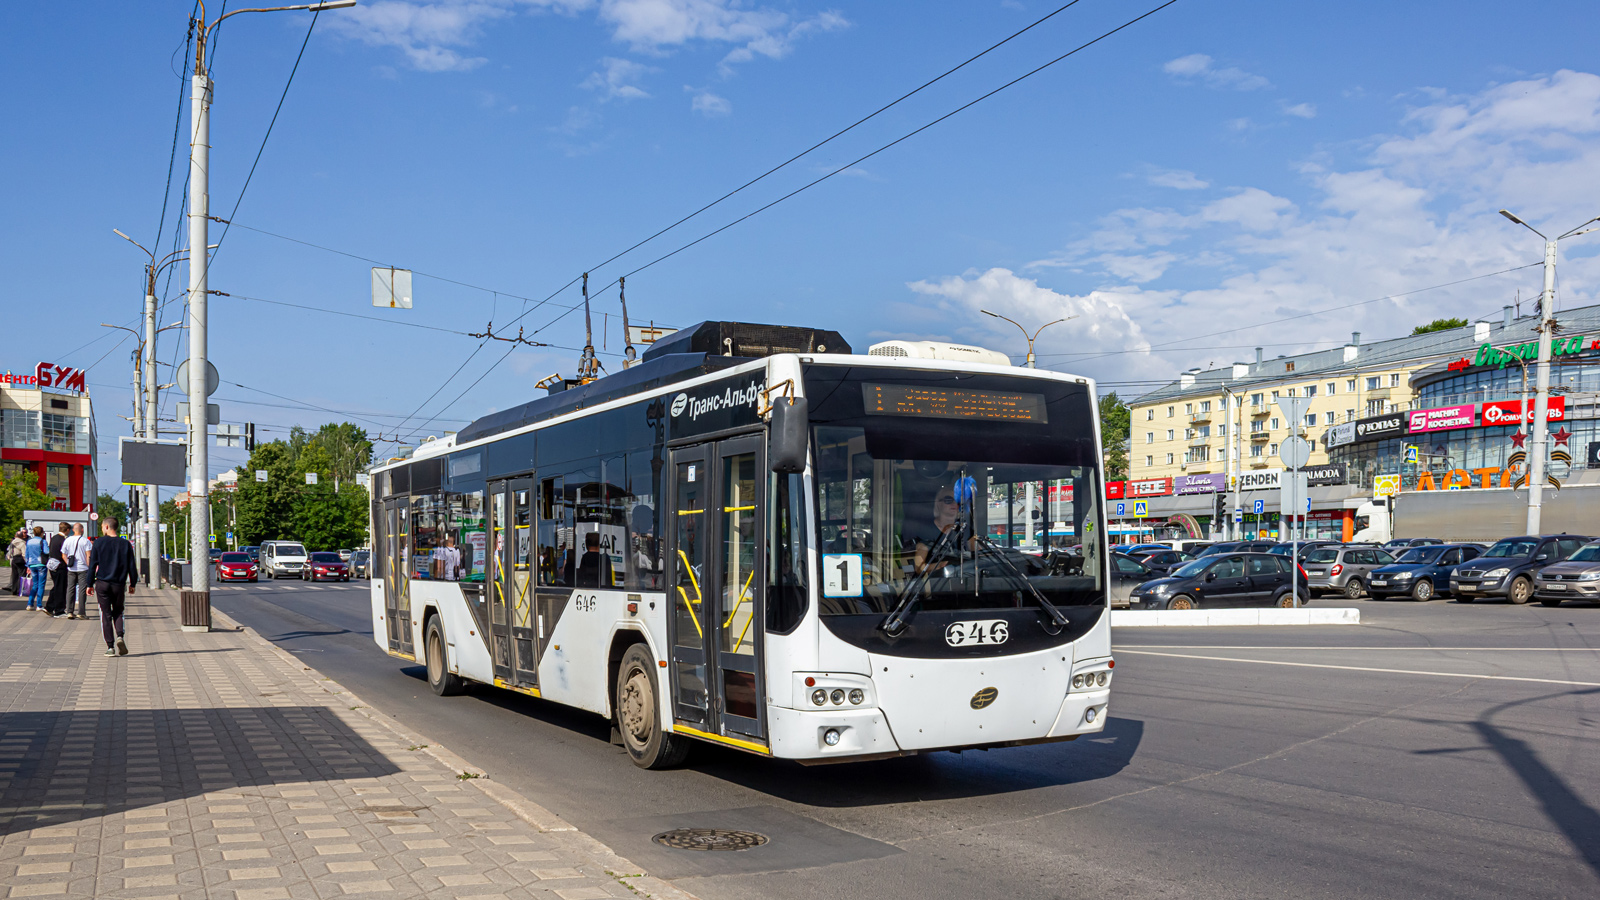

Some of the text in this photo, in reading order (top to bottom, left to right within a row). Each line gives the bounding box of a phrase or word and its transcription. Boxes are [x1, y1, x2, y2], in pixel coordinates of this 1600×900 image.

[35, 361, 85, 393] БУМ
[688, 380, 764, 421] Транс-Альфа
[1428, 408, 1460, 420] МАГНИТ
[1365, 418, 1400, 432] ТОПАЗ
[1428, 416, 1471, 429] КОСМЕТИК
[1240, 473, 1278, 486] ZENDEN
[1306, 468, 1340, 479] ALMODA
[1379, 486, 1394, 494] GEO
[836, 560, 849, 592] 1
[576, 594, 597, 612] 646
[946, 620, 1008, 646] 646
